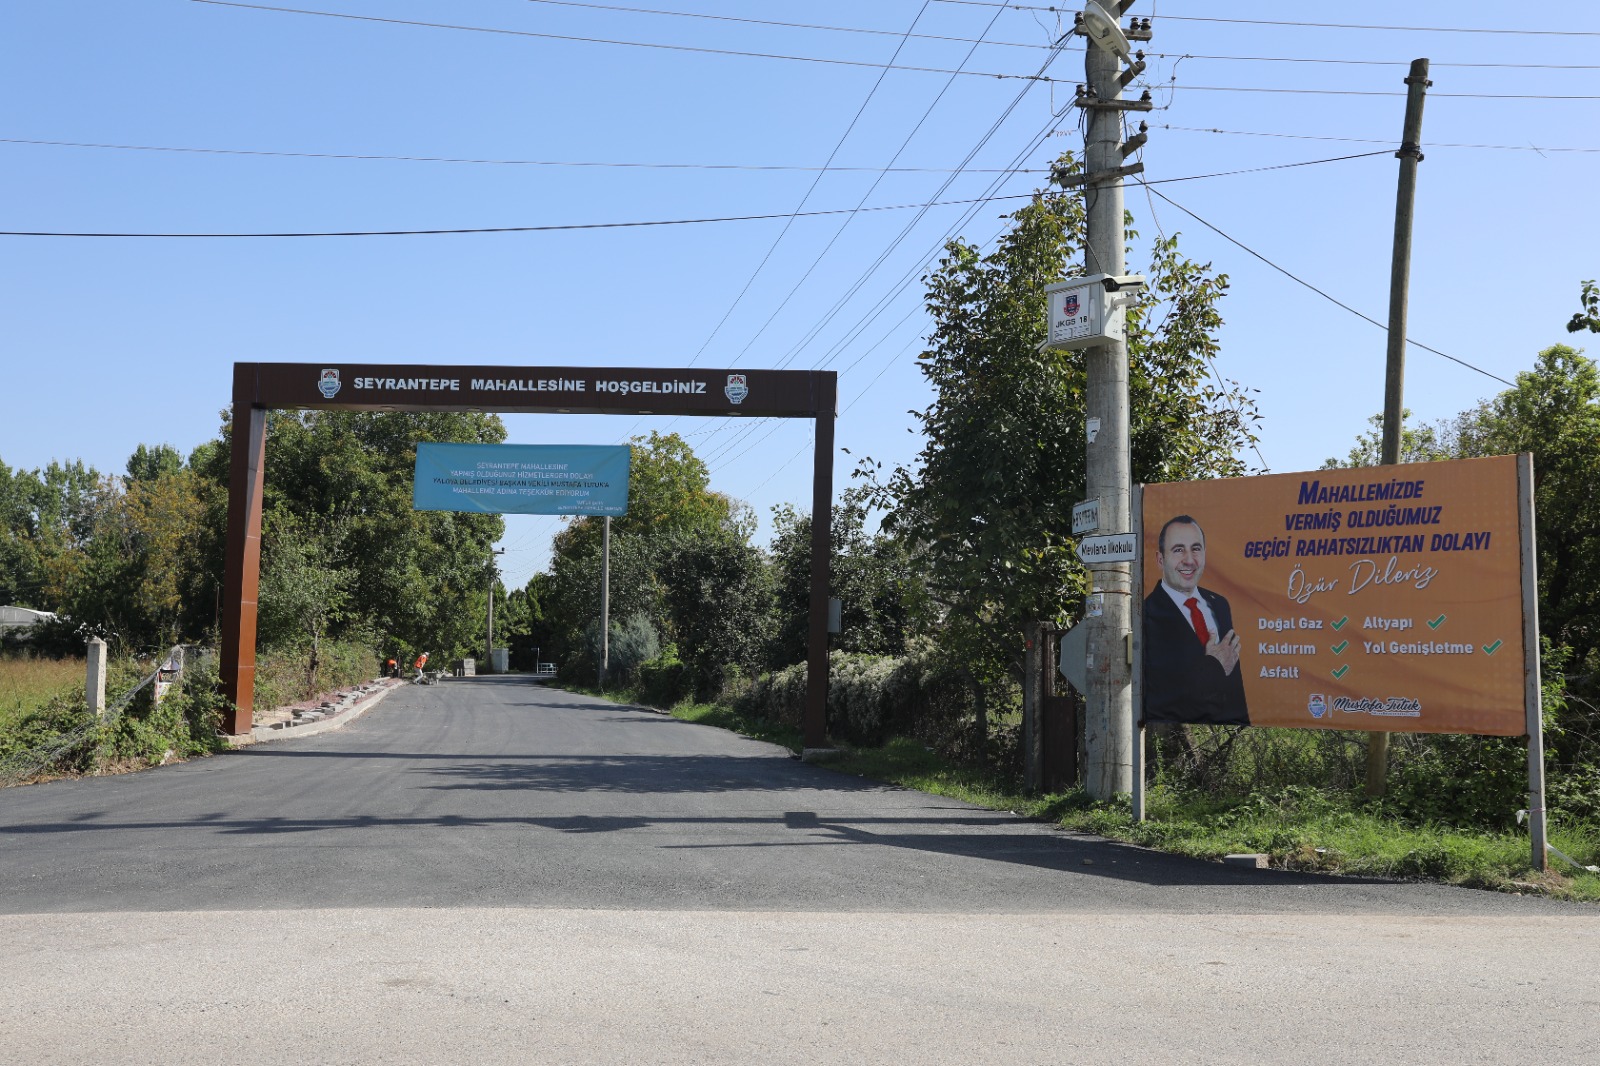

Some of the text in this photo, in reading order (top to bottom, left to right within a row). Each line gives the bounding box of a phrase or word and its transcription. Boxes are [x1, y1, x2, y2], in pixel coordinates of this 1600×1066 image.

[1055, 318, 1076, 328] JKGS
[353, 377, 707, 396] SEYRANTEPE MAHALLESİNE HOŞGELDİNİZ
[450, 470, 594, 480] YAPMIŞ OLDUĞUNUZ HİZMETLERDEN DOLAYI
[433, 477, 458, 485] YALOVA
[459, 478, 498, 486] BELEDİYESİ
[499, 479, 527, 488] BAŞKAN
[519, 488, 554, 497] TEŞEKKÜR
[555, 489, 590, 497] EDİYORUM
[1285, 504, 1442, 533] VERMİŞ OLDUĞUMUZ
[1081, 543, 1107, 556] Mevlana
[1244, 531, 1491, 561] GEÇİCİ RAHATSIZLIKTAN DOLAYI
[1287, 555, 1438, 604] Özür Dileriz
[1258, 617, 1323, 632] Doğal Gaz
[1363, 617, 1413, 631] Altyapı
[1258, 642, 1316, 655] Kaldırım
[1363, 641, 1474, 656] Yol Genişletme
[1259, 665, 1300, 679] Asfalt
[1333, 697, 1420, 712] Mustafa Tutuk
